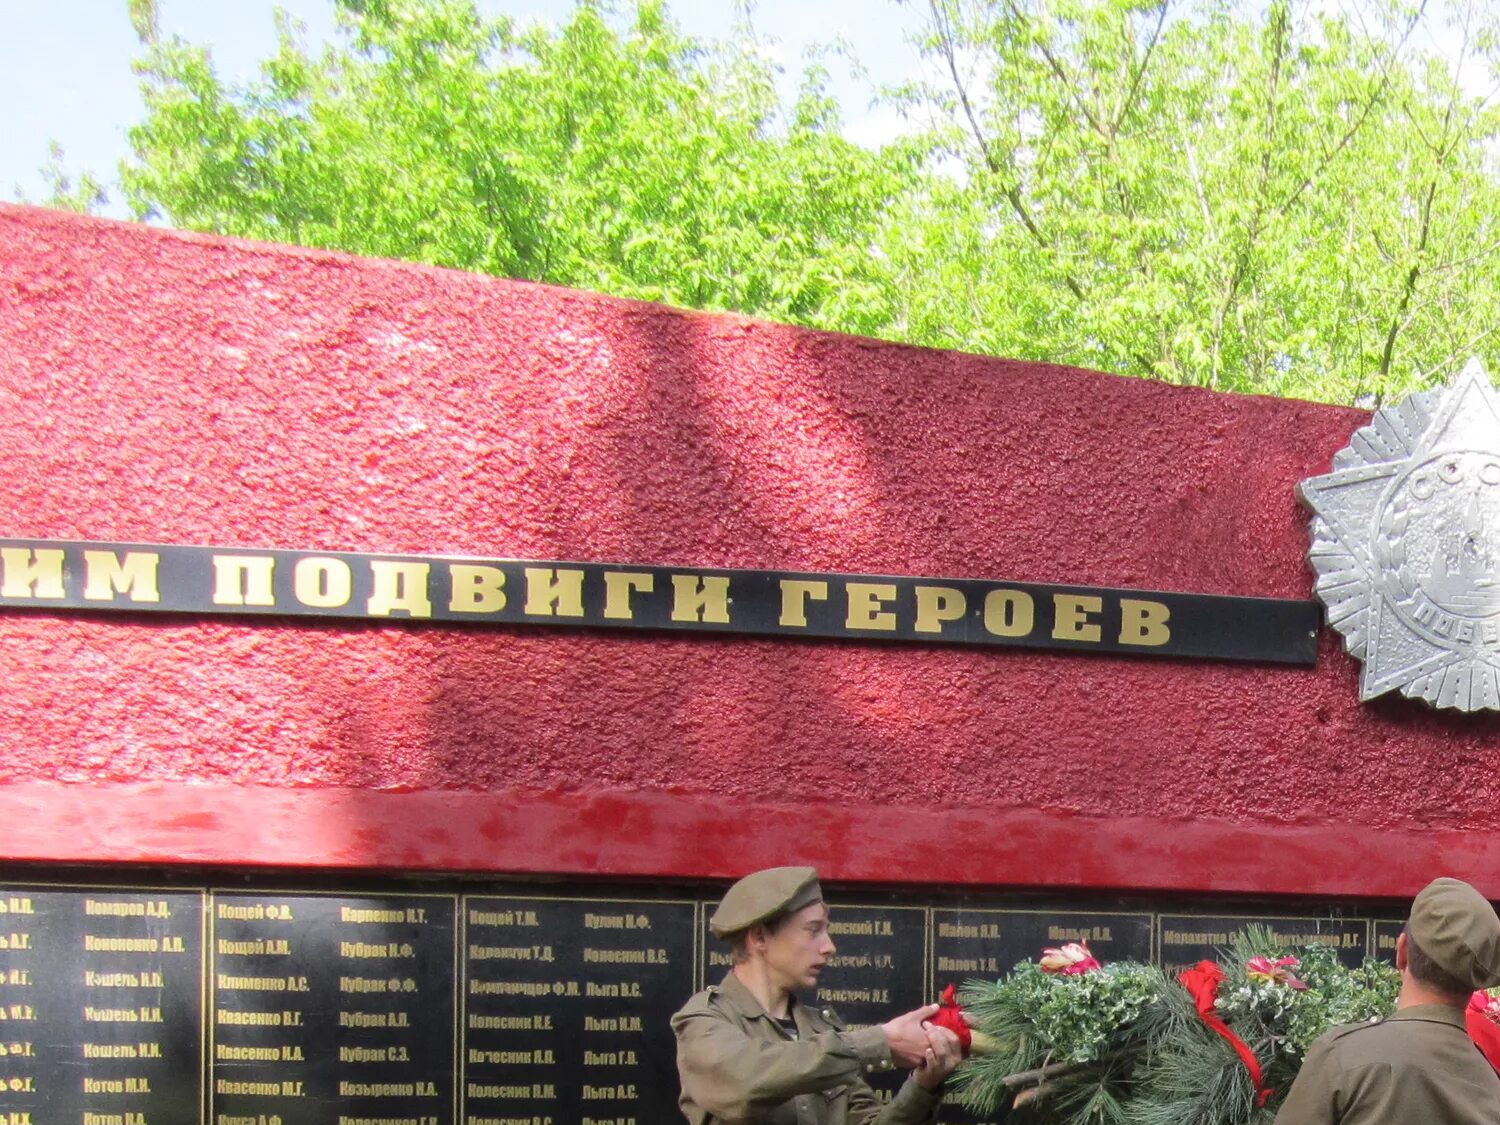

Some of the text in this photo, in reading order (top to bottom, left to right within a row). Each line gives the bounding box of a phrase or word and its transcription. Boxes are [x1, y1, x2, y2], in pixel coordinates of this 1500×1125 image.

[0, 548, 1171, 646] ИМ ПОДВИГИ ГЕРОЕВ
[86, 900, 144, 916] Комаров
[218, 904, 264, 920] Кощей
[340, 906, 403, 924] Карпенко
[218, 939, 263, 955] Кощей
[341, 942, 386, 958] Кубрак
[216, 973, 309, 991] Клименко А.С.
[340, 977, 386, 993] Кубрак
[586, 982, 618, 996] Лыга
[218, 1009, 280, 1025] Квасенко
[340, 1012, 386, 1027] Кубрак
[470, 1014, 531, 1029] Колесник
[585, 1017, 617, 1031] Лыга
[84, 1043, 136, 1057] Кошель
[217, 1045, 279, 1060] Квасенко
[340, 1047, 385, 1062] Кубрак
[584, 1051, 616, 1065] Лыга
[84, 1078, 123, 1093] Котов
[218, 1080, 305, 1096] Квасенко М.Г.
[340, 1081, 413, 1097] Козыренко
[468, 1083, 530, 1098] Колесник
[583, 1085, 638, 1099] Лыга А.С.
